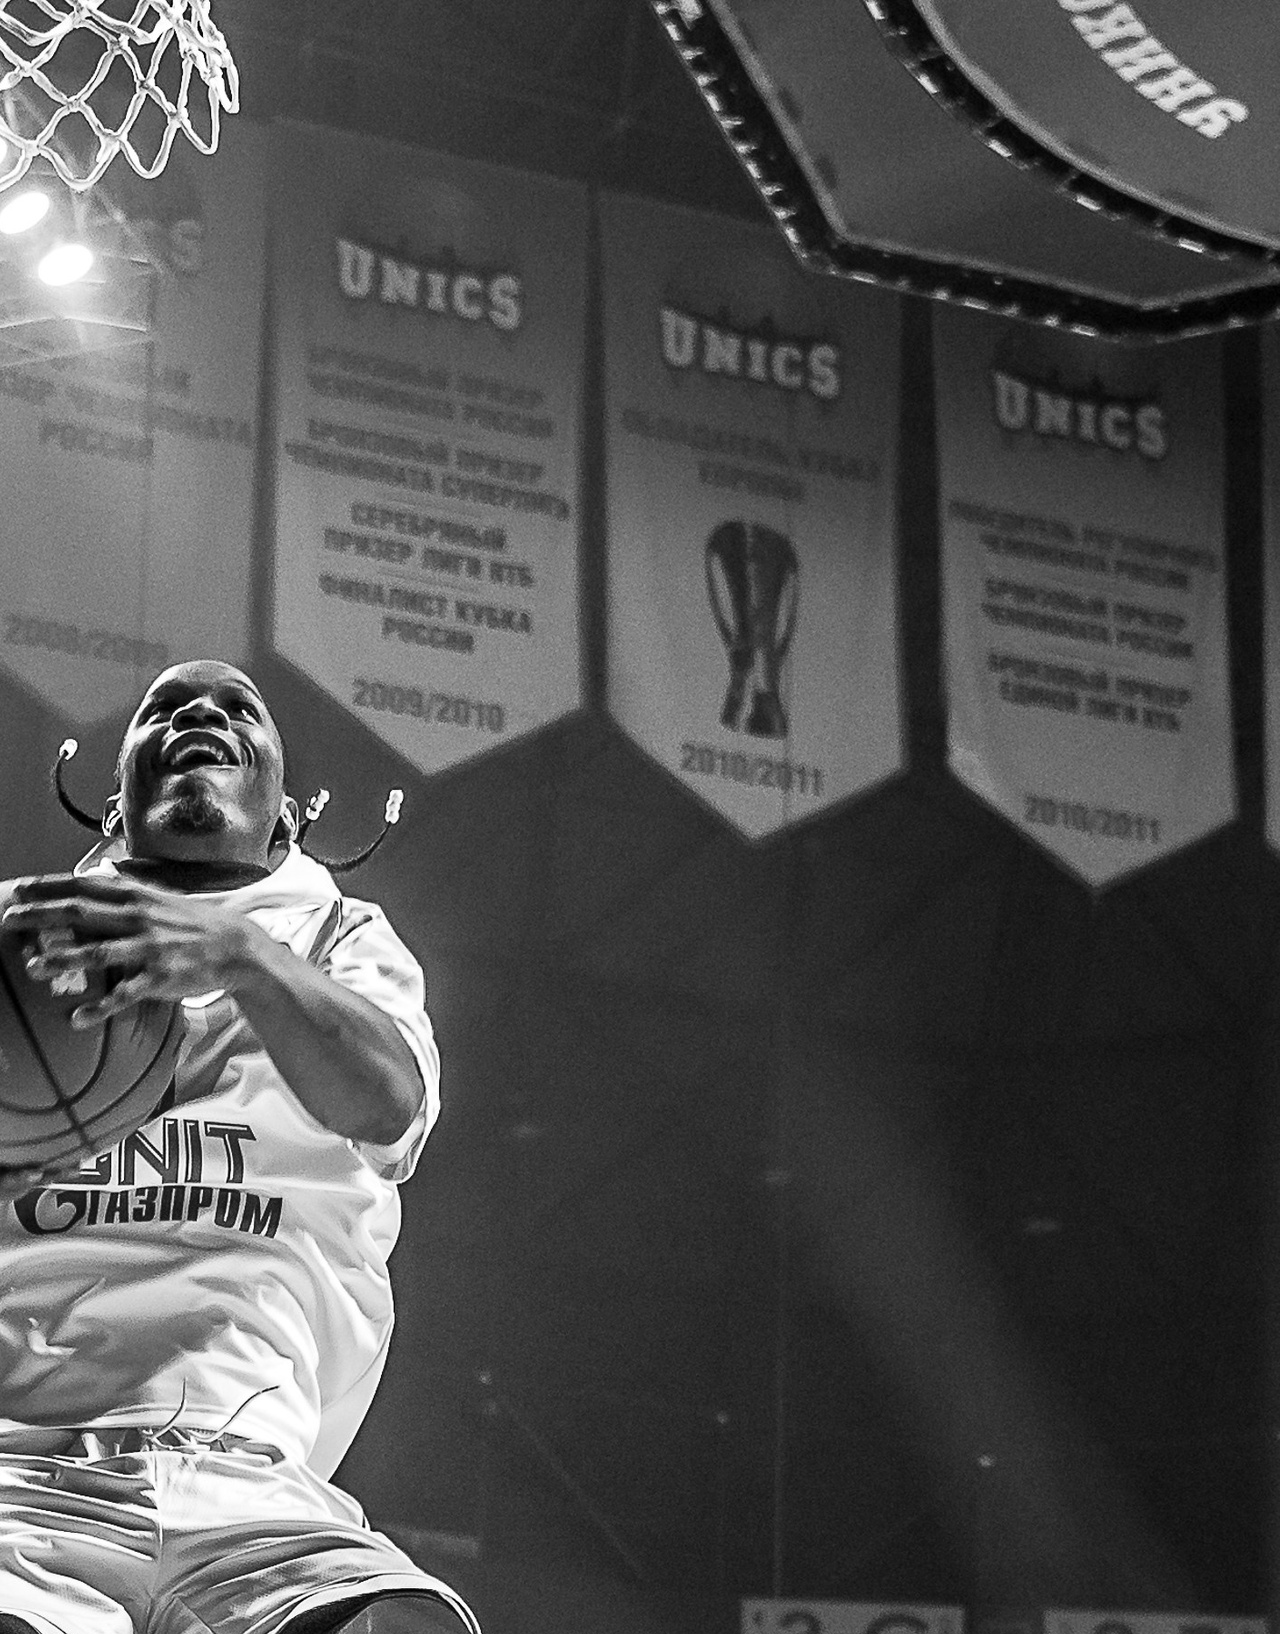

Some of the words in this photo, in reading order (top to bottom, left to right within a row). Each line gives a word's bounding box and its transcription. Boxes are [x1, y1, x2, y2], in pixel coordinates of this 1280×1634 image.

[1057, 0, 1251, 140] УНИК
[335, 236, 521, 331] UNICS
[660, 306, 841, 400] UNICS
[992, 369, 1166, 459] UNICS
[352, 676, 506, 734] 2009/2010
[680, 740, 824, 798] 2010/2011
[1023, 794, 1161, 846] 2010/2011
